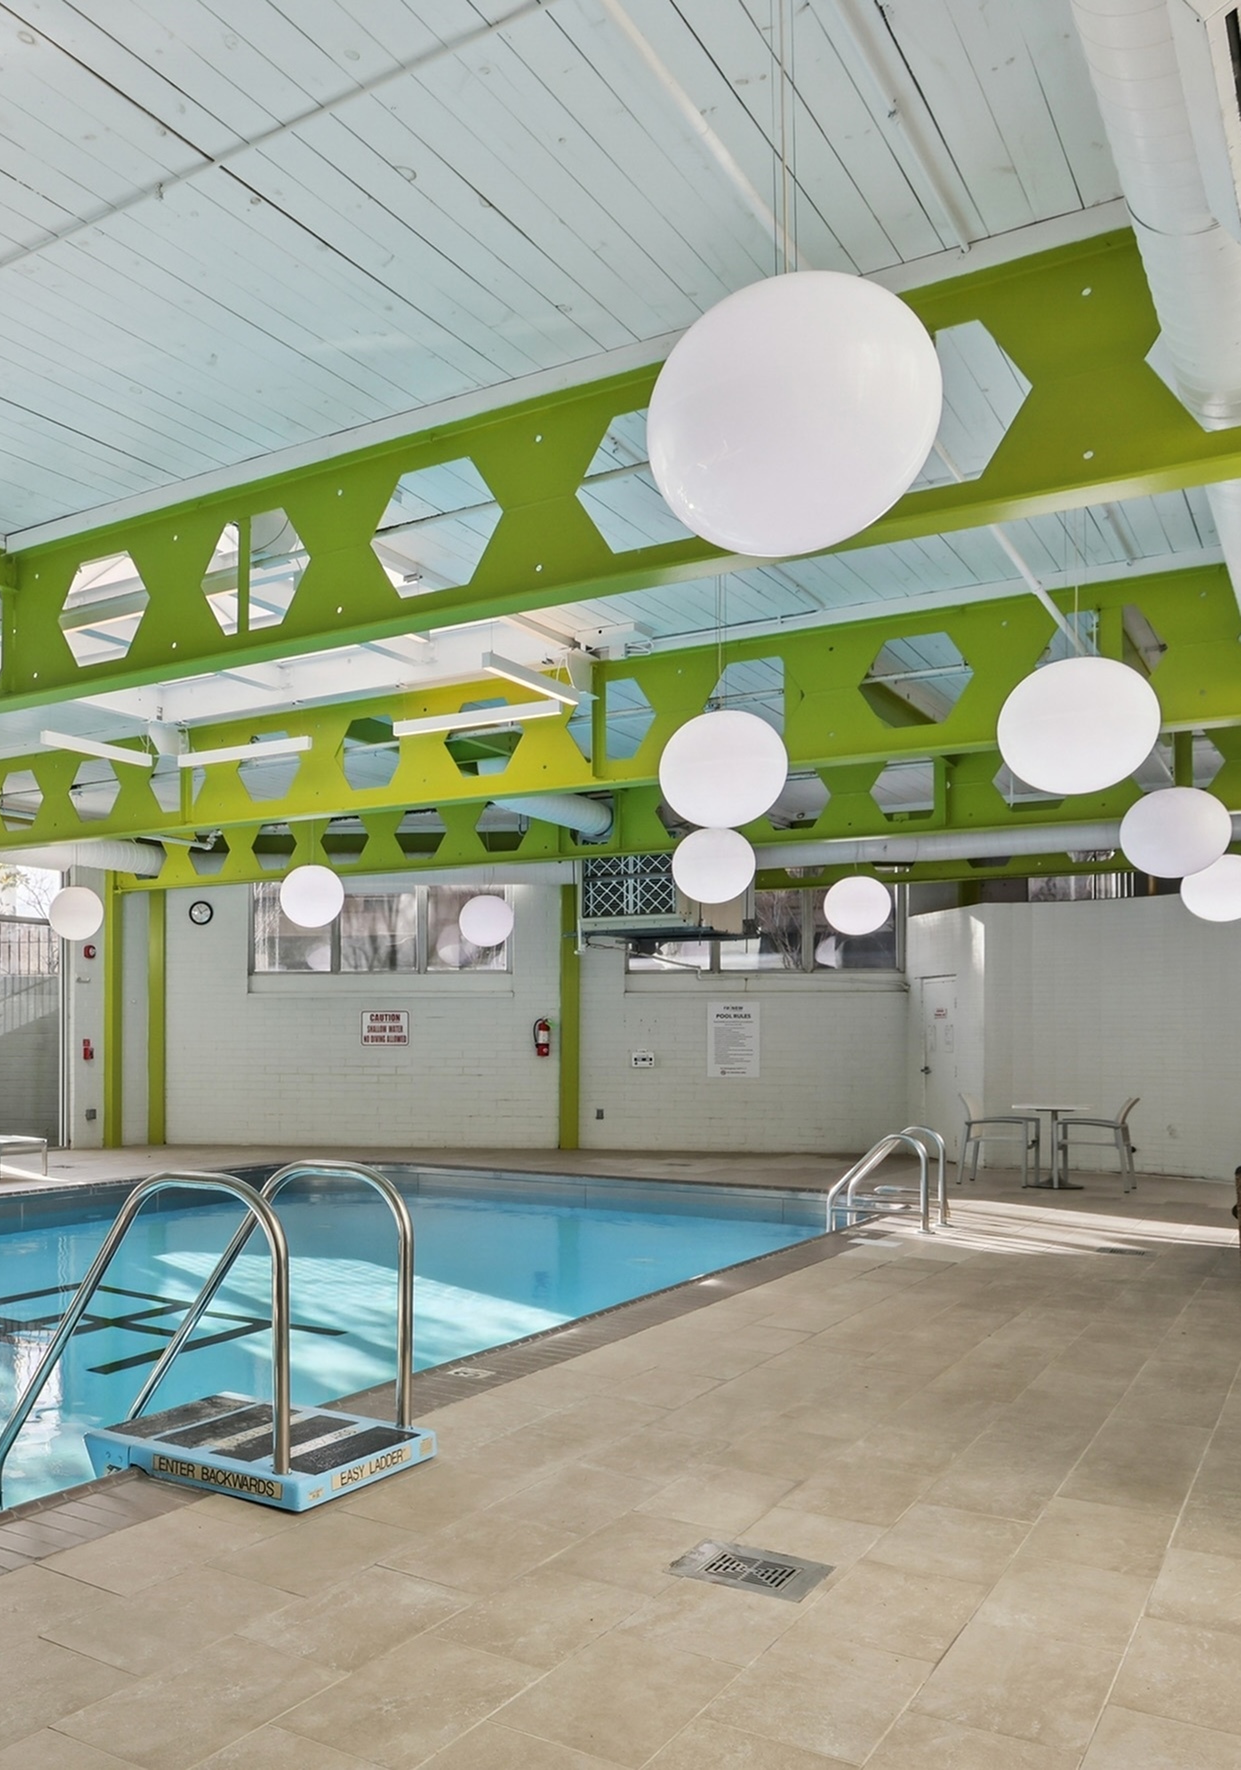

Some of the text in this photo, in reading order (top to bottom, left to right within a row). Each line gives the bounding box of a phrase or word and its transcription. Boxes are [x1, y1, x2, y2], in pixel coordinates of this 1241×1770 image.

[369, 1013, 401, 1021] CAUTION
[158, 1456, 275, 1497] ENTER BACKWARDS
[340, 1448, 403, 1486] EASY LADDER
